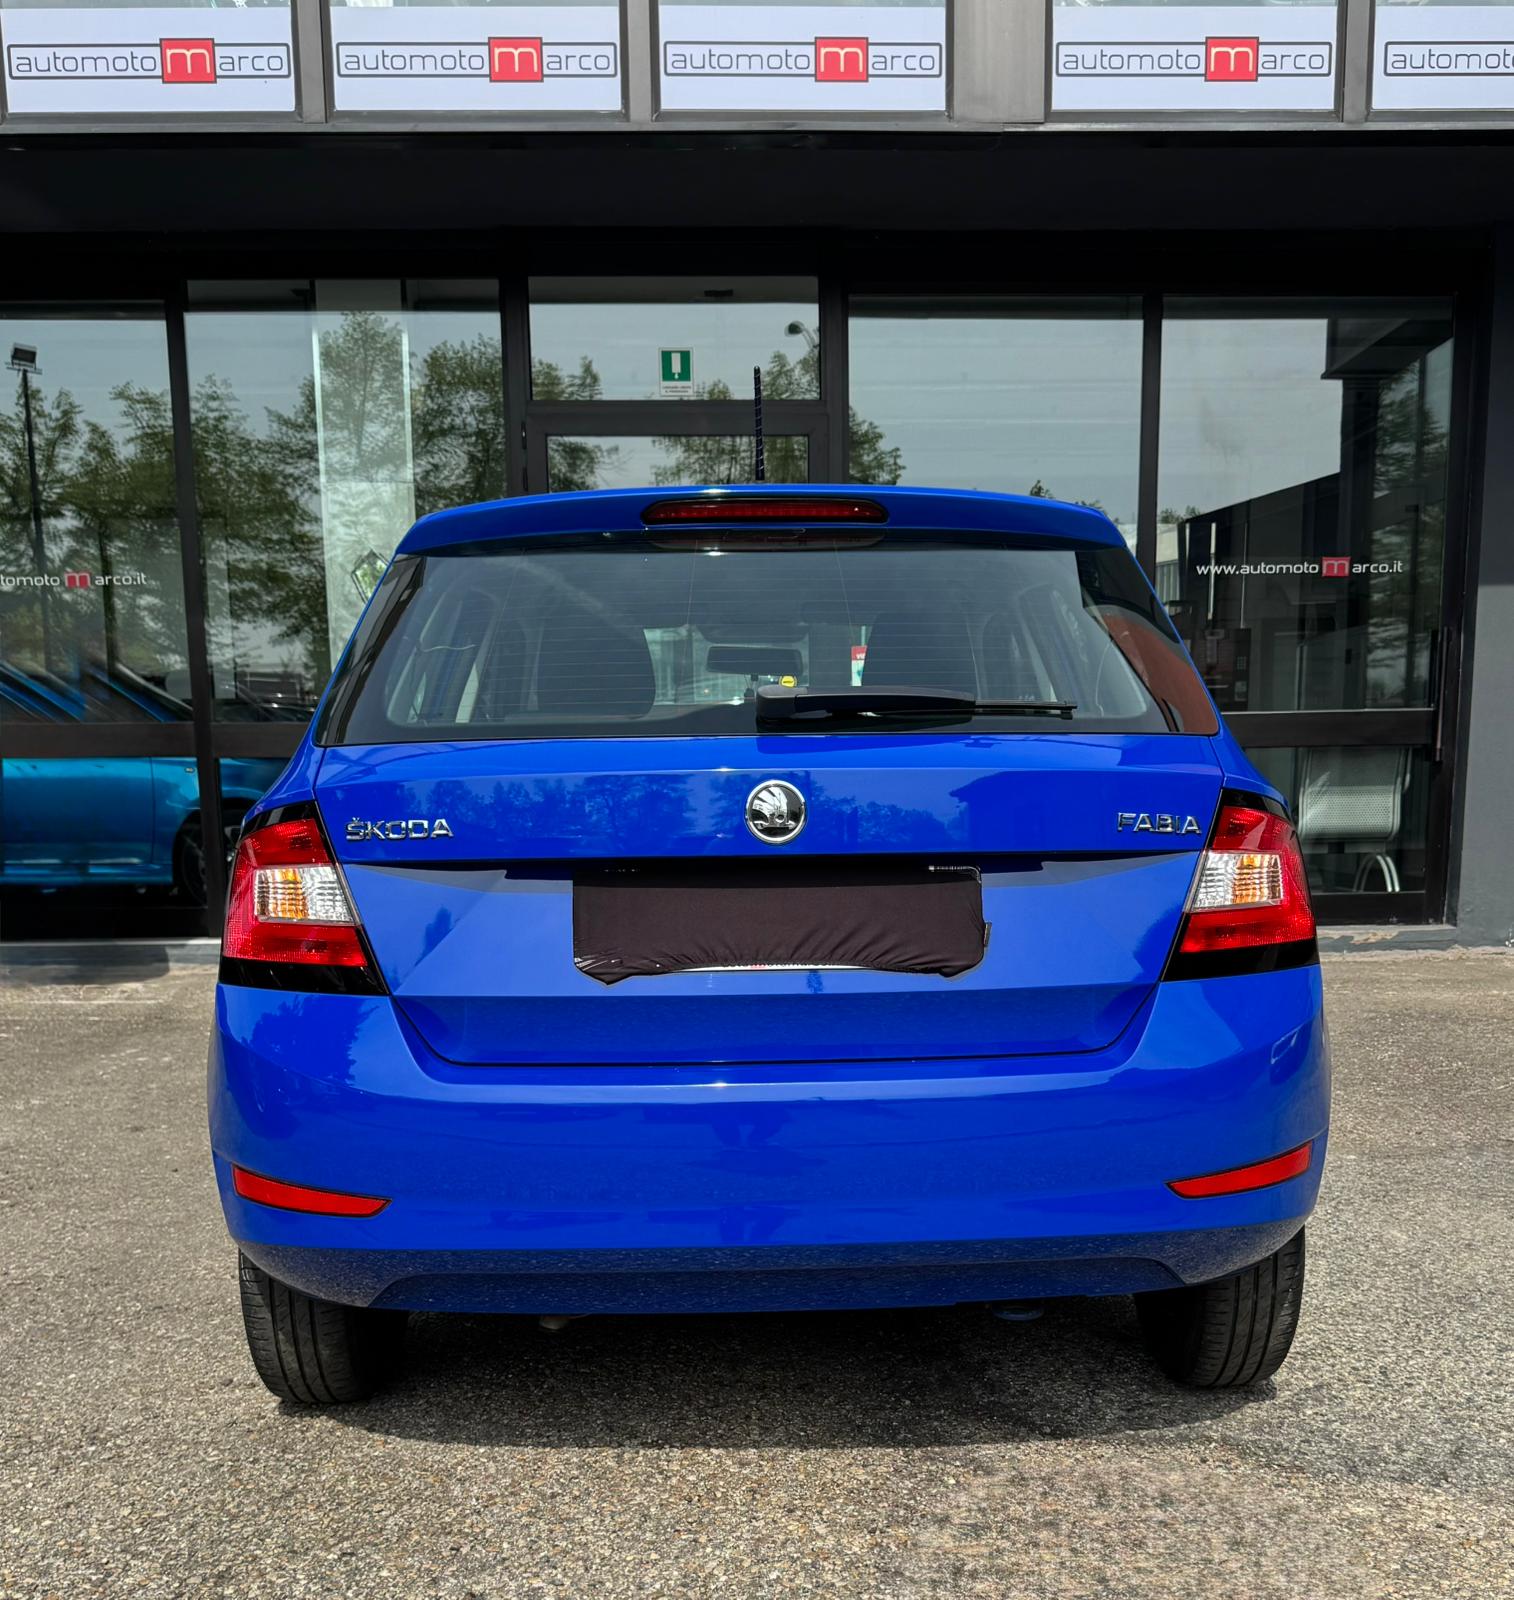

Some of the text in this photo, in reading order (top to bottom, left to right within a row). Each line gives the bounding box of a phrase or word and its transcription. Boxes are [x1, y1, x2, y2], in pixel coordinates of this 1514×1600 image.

[1391, 48, 1514, 69] automot
[345, 817, 454, 840] ŠKODA
[1117, 812, 1202, 834] FABIA
